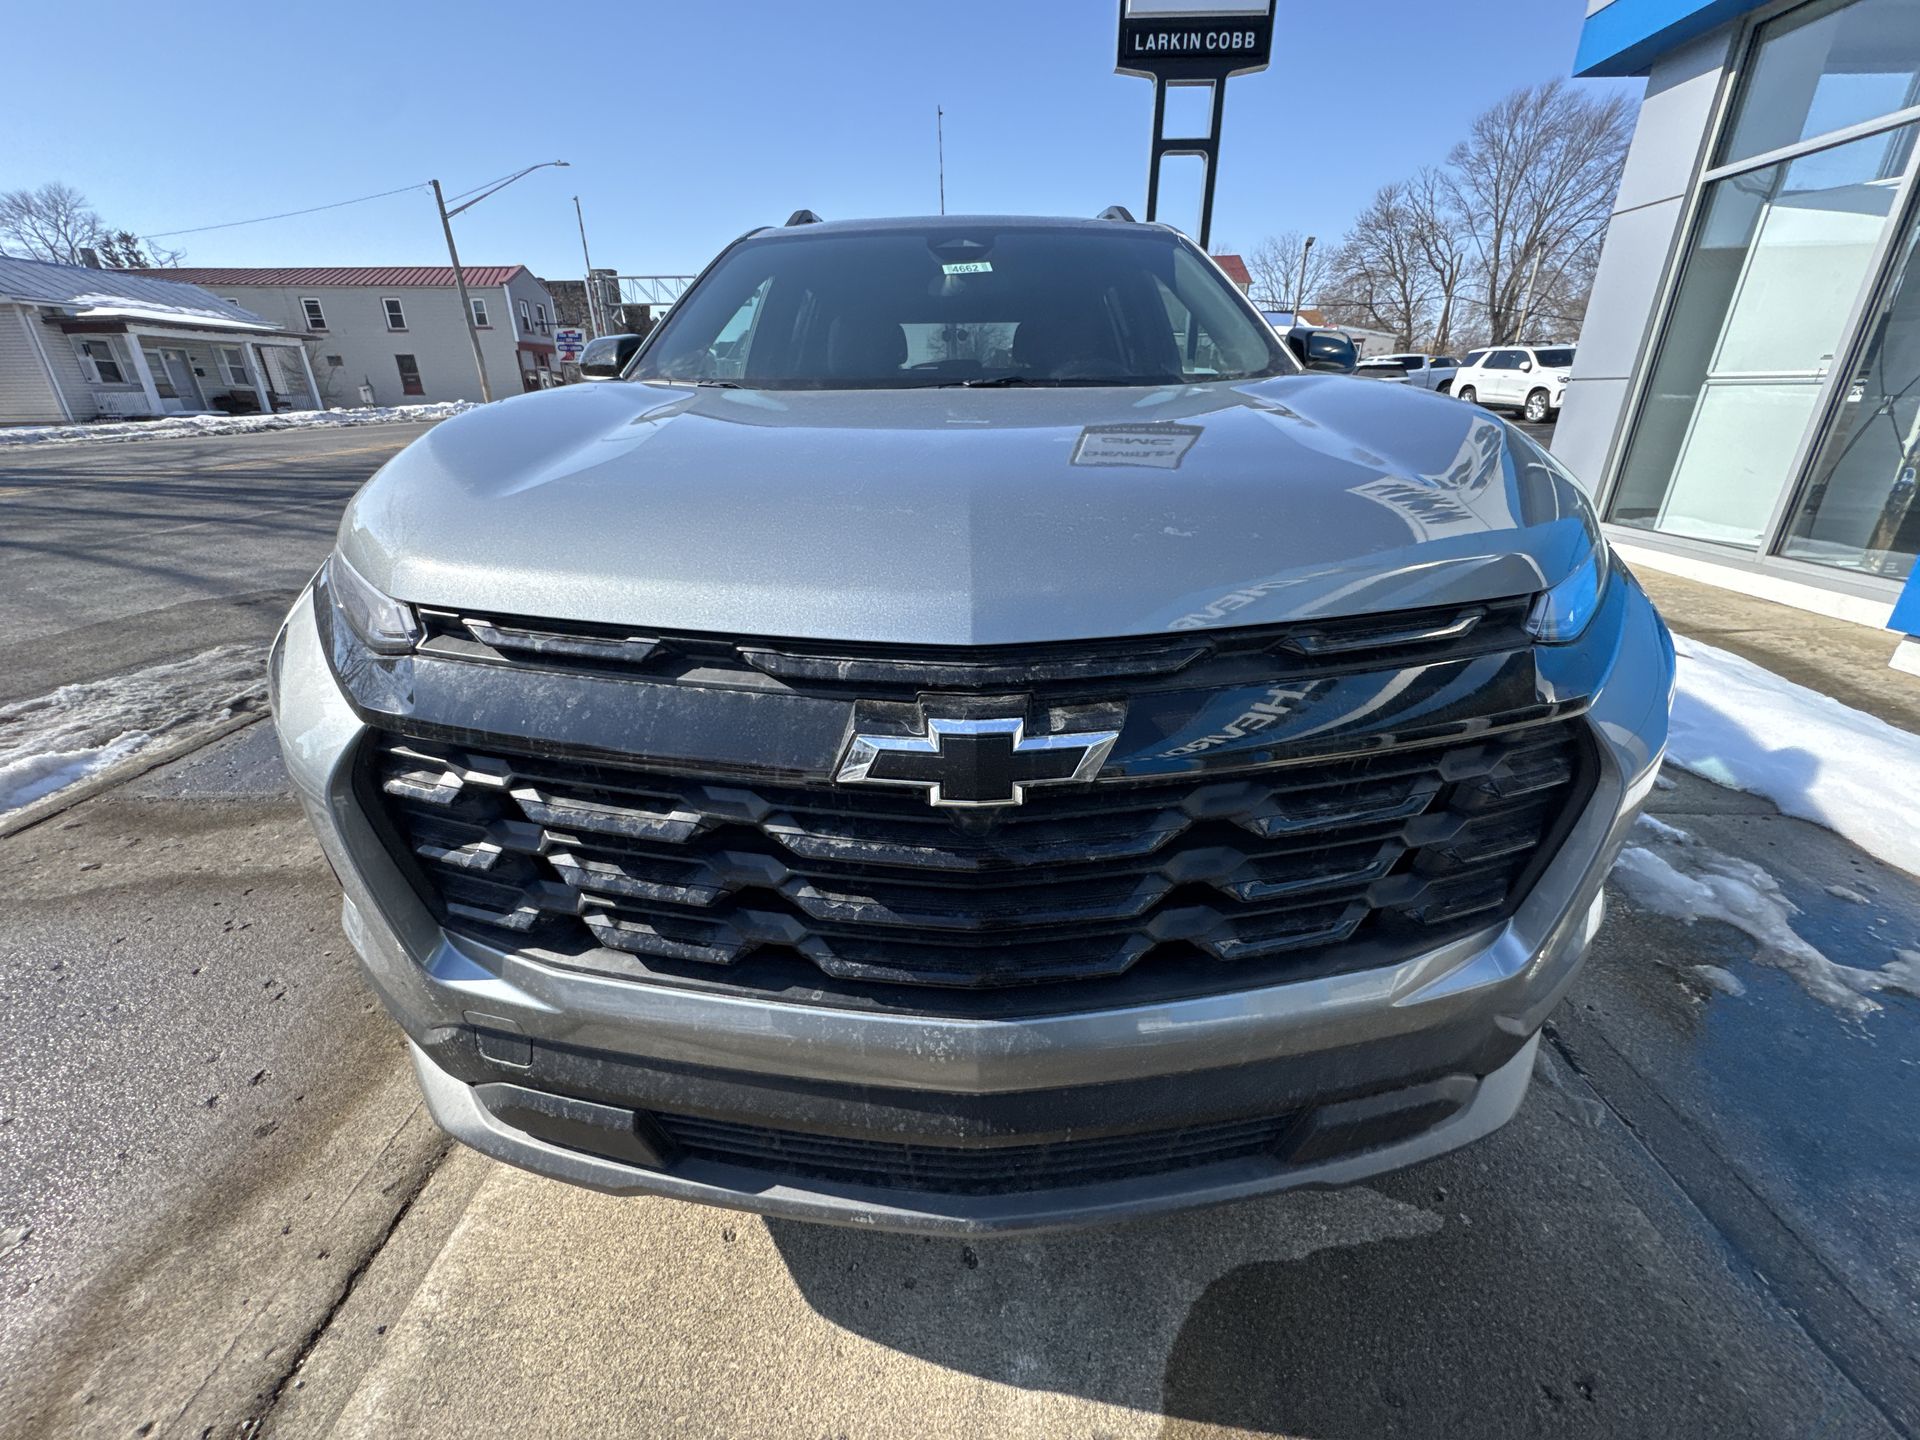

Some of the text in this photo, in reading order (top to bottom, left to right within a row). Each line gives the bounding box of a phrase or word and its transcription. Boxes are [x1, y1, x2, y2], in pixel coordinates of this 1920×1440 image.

[1134, 31, 1256, 51] LARKIN COBB
[952, 264, 979, 273] 4662
